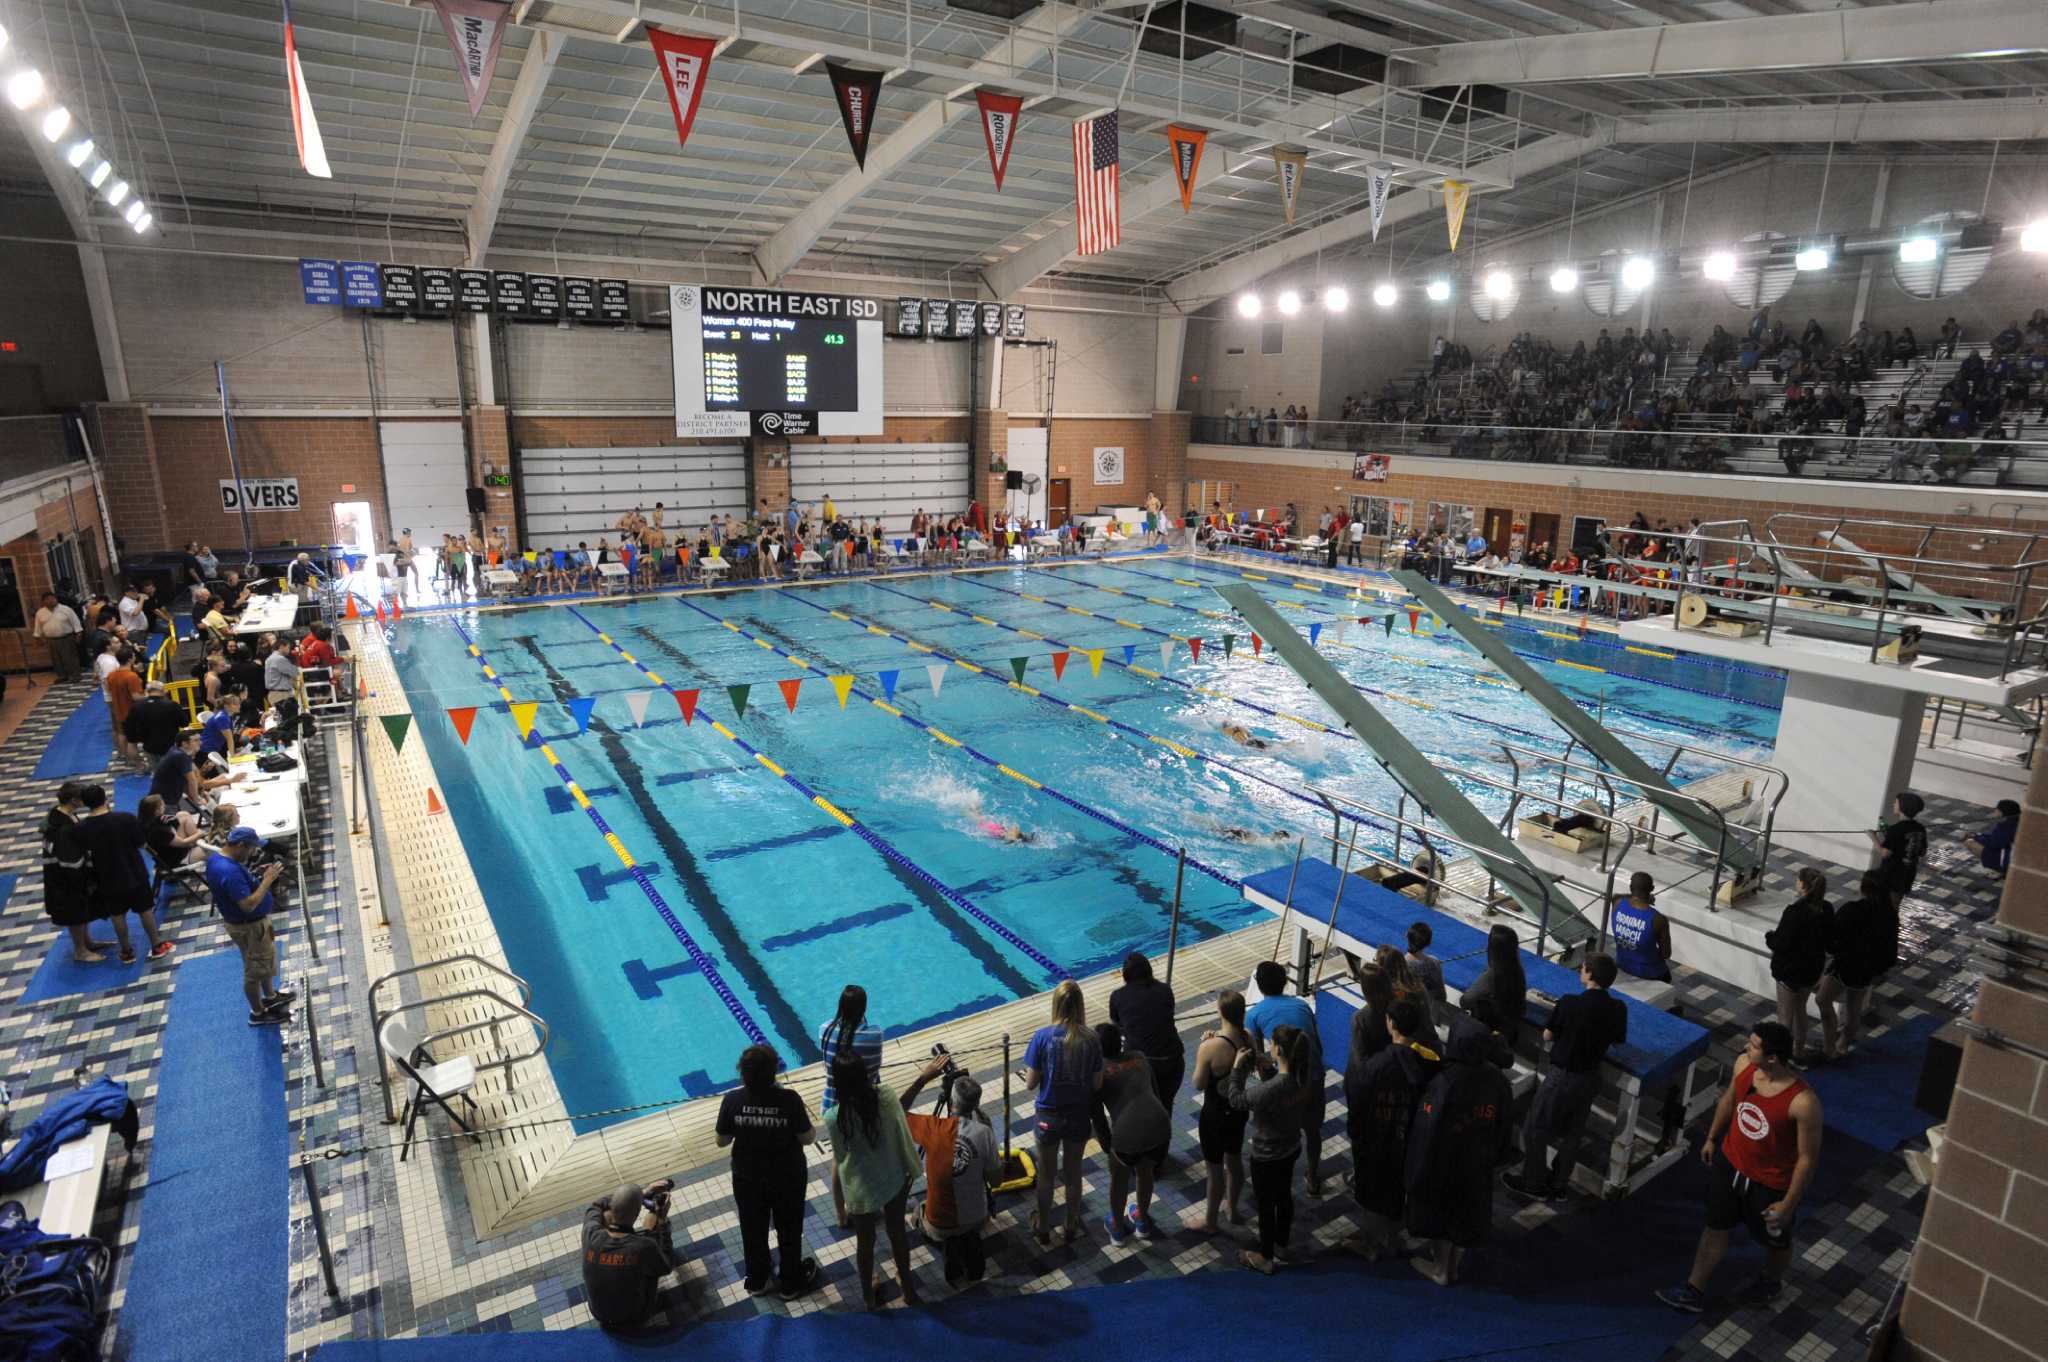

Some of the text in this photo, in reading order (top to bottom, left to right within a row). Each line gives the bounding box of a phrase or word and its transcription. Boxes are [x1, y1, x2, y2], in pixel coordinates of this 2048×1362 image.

[675, 56, 691, 90] LEE
[706, 291, 781, 313] NORTH
[788, 295, 840, 315] EAST
[846, 299, 878, 318] ISD
[736, 317, 752, 326] 400
[753, 318, 772, 327] Free
[773, 318, 796, 331] Relay
[775, 333, 780, 341] 1
[824, 333, 844, 345] 41.3
[677, 420, 749, 428] DISTRICT PARTNER
[783, 427, 805, 435] Cable
[222, 485, 298, 508] DVERS
